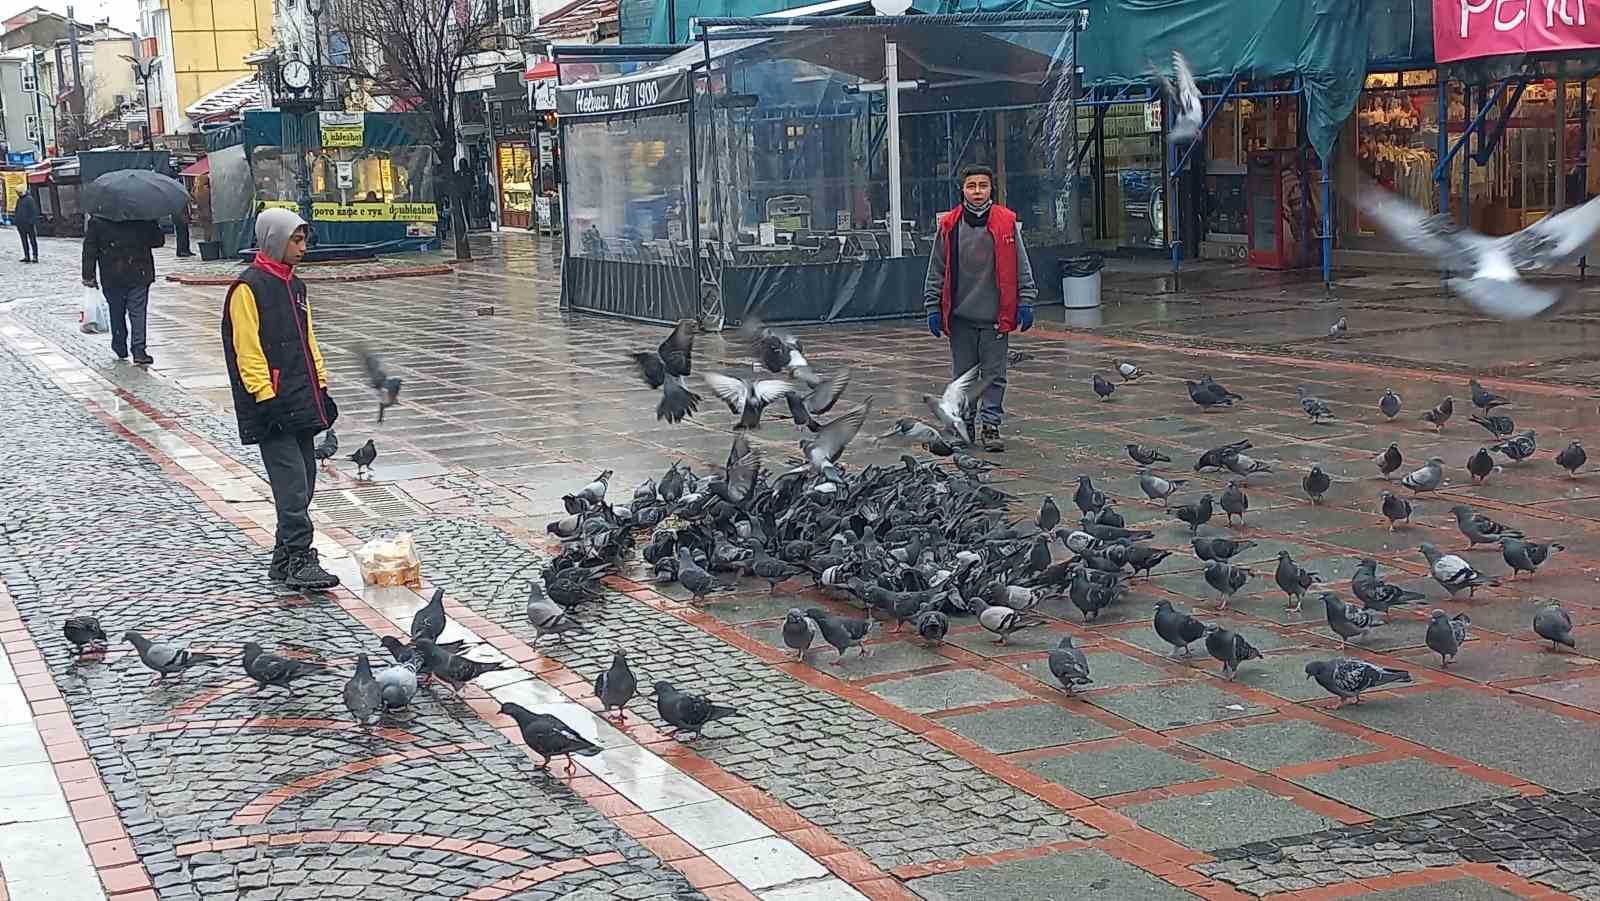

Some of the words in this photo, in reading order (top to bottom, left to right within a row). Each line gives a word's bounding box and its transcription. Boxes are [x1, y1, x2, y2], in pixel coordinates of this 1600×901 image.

[613, 84, 630, 109] Ali
[635, 81, 659, 106] 1900
[314, 207, 334, 218] рото
[389, 204, 435, 219] doubleshot
